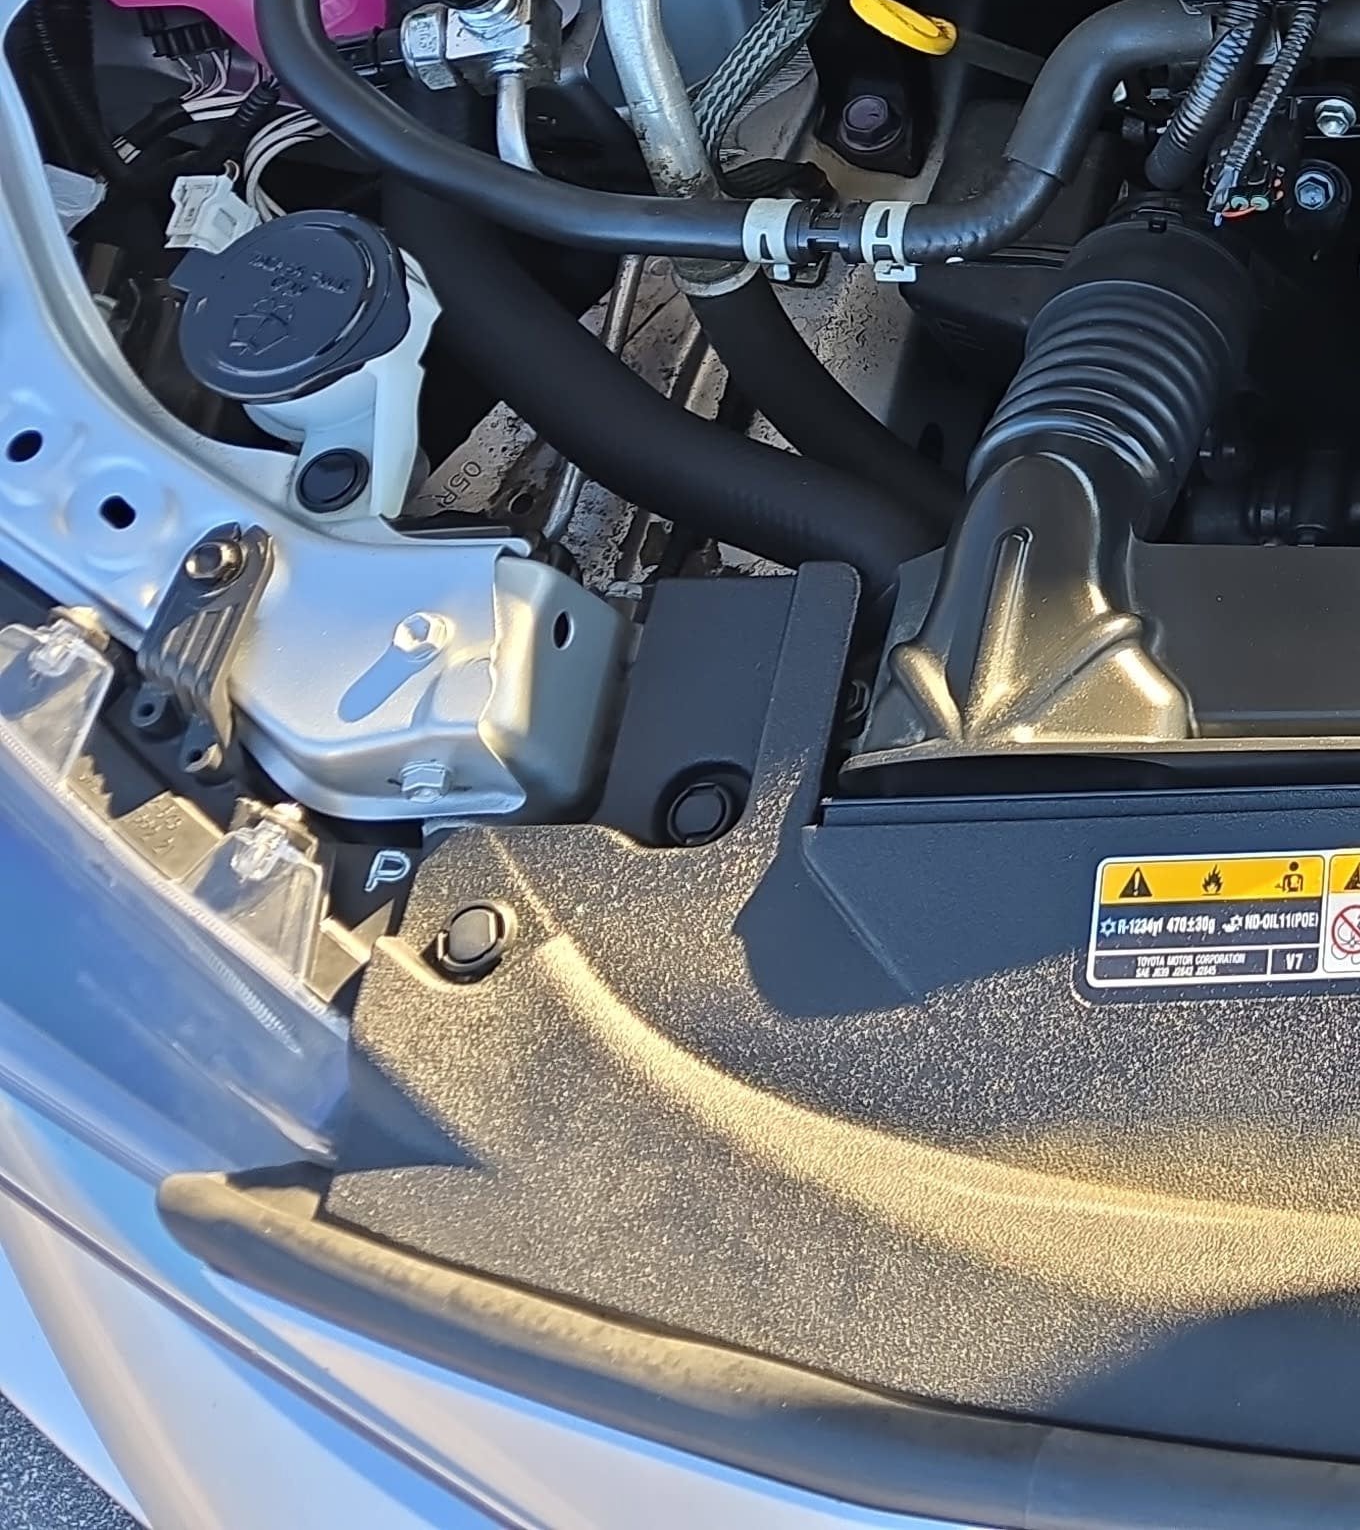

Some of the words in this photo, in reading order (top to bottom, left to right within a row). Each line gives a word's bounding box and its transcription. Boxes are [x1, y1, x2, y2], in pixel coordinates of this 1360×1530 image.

[1166, 915, 1216, 935] 470±30g
[1245, 912, 1319, 930] ND-OIL11(POE)
[1137, 956, 1165, 968] TOYOTA
[1167, 955, 1193, 967] MOTOR
[1195, 953, 1246, 966] CORPORATION
[1286, 953, 1304, 970] V7
[1136, 968, 1150, 978] SAE
